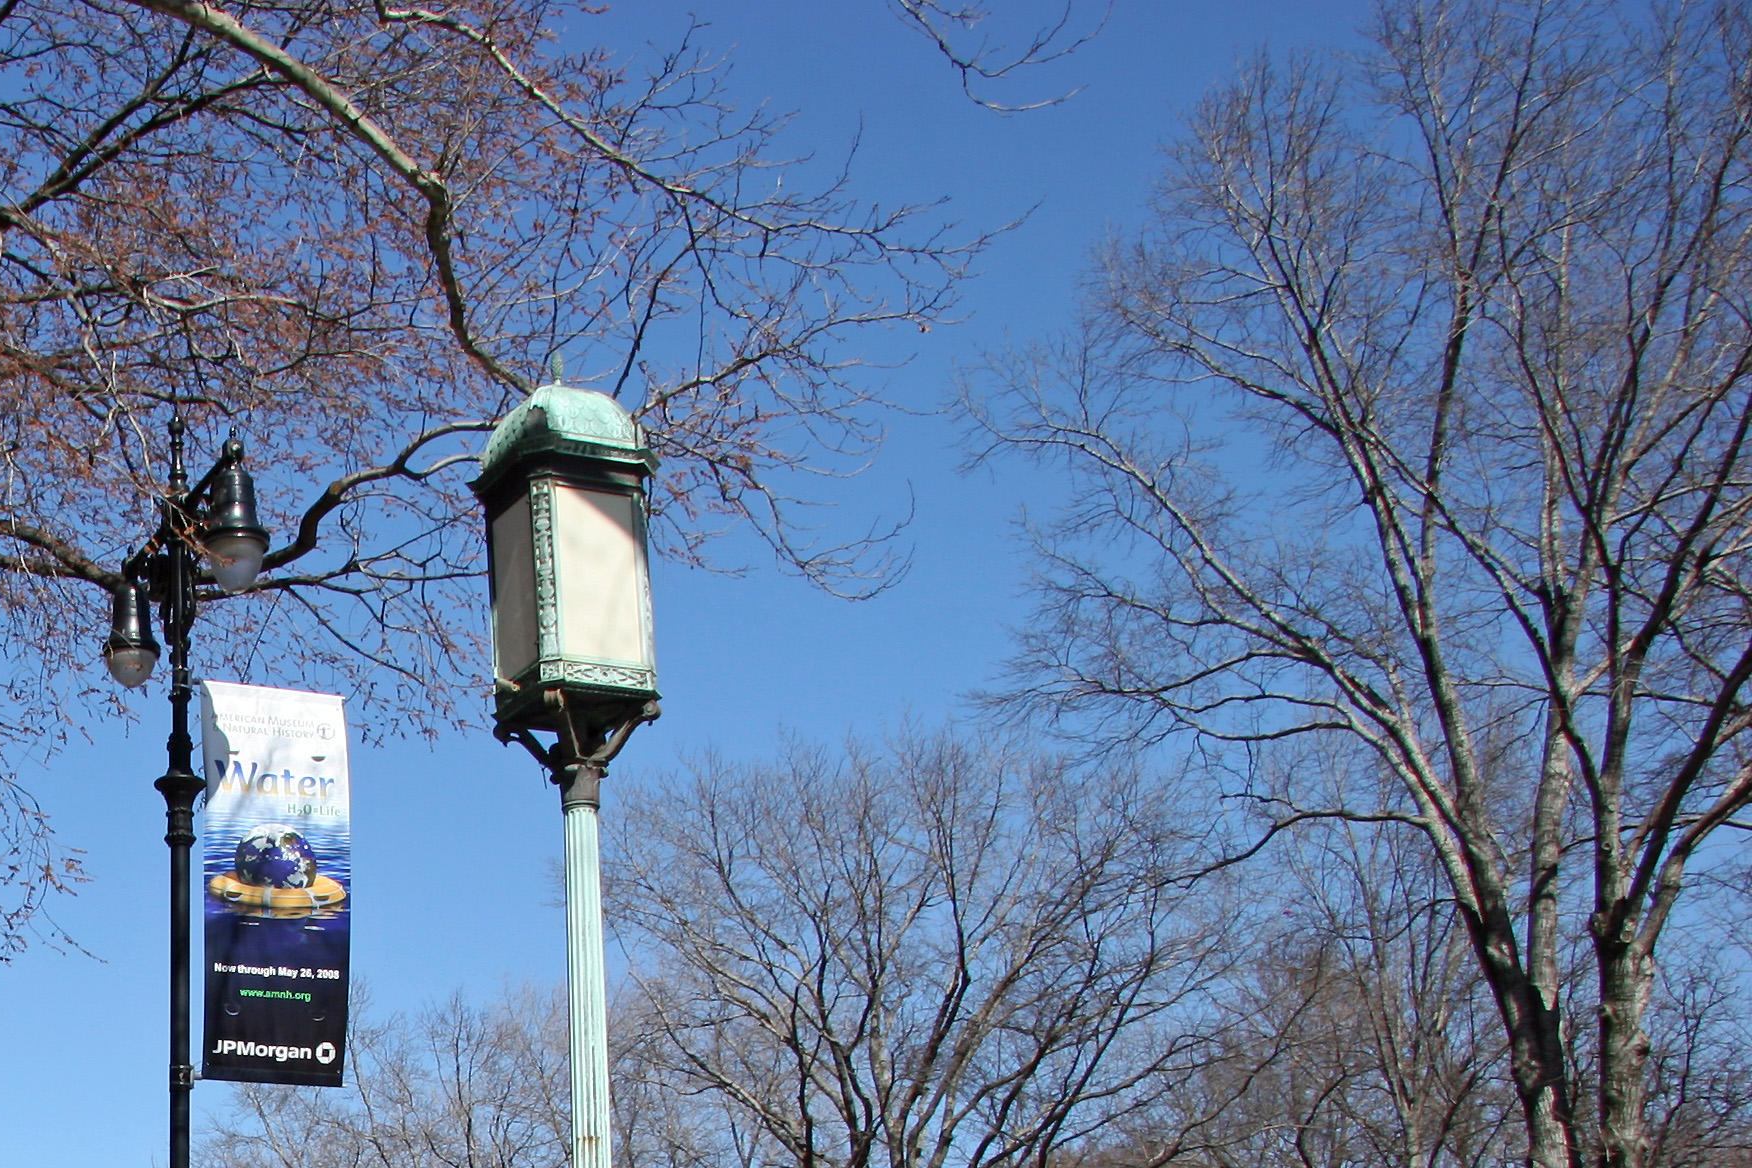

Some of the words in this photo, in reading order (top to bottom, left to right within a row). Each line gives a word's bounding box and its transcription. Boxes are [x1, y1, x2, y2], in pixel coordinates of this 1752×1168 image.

[223, 722, 268, 736] NATURAL
[273, 726, 313, 739] HISTORY
[268, 715, 314, 729] MUSEUM
[214, 759, 335, 797] Water
[214, 962, 236, 973] Now
[237, 964, 276, 977] through
[278, 966, 298, 979] May
[316, 969, 340, 980] 2008
[239, 989, 312, 1002] www.amnh.org
[212, 1039, 312, 1062] JPMorgan
